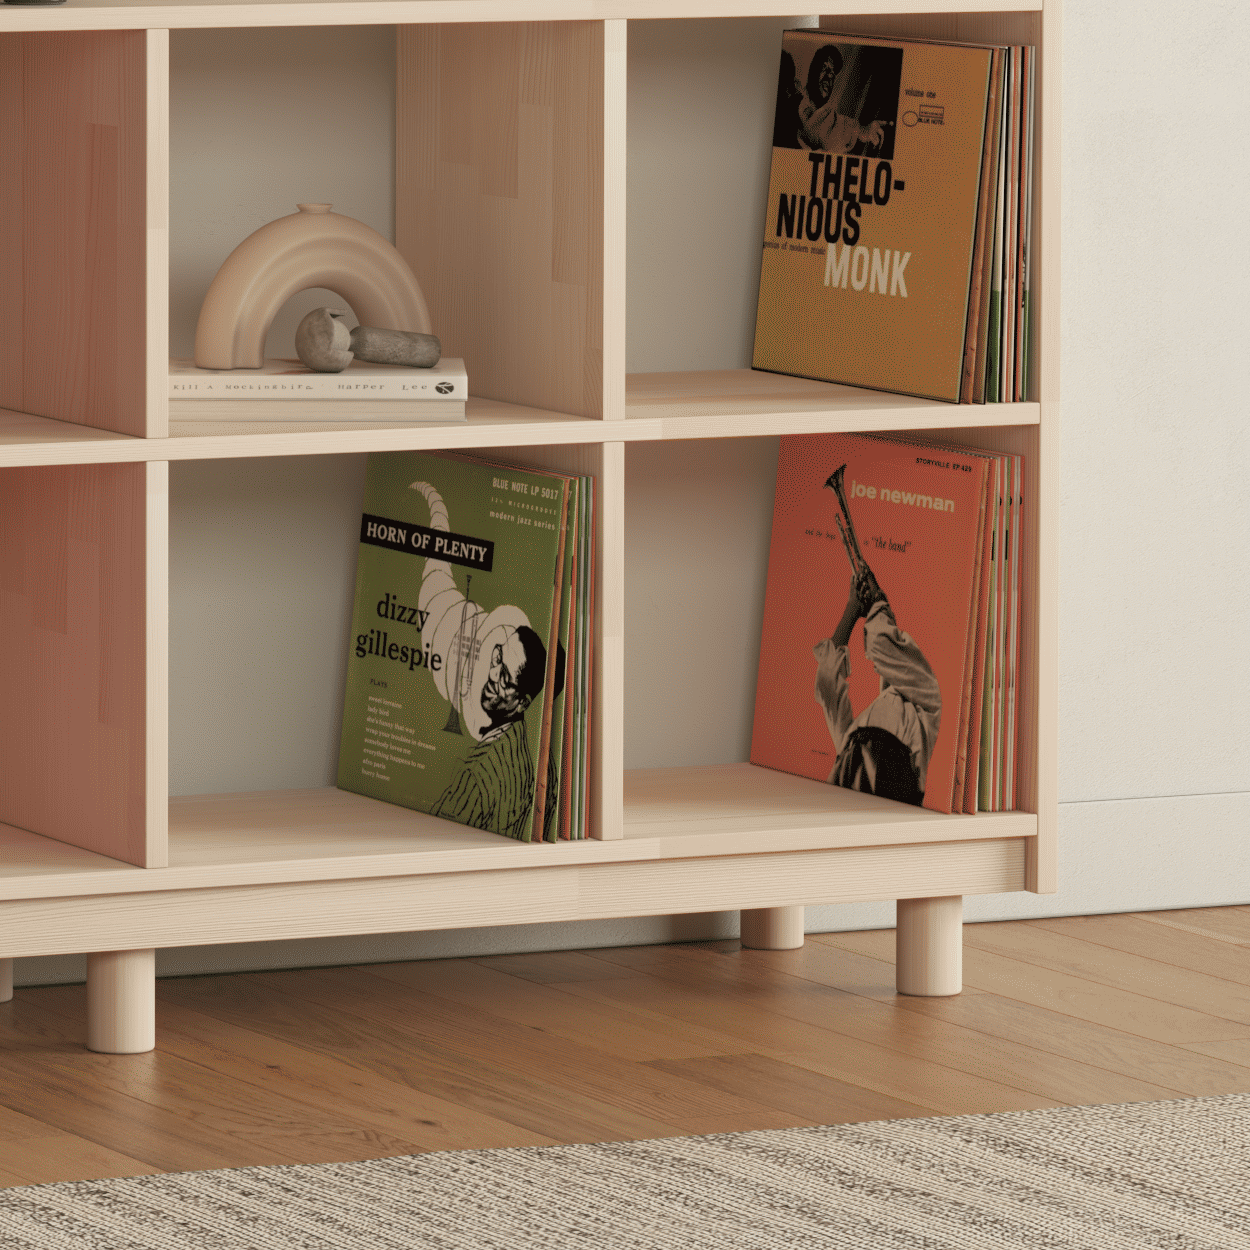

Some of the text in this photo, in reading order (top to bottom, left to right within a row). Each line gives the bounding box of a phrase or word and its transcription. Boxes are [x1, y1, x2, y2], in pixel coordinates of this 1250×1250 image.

[904, 87, 937, 99] volume one
[808, 152, 905, 206] THELO-
[776, 193, 862, 247] NIOUS
[824, 243, 912, 298] MONK
[402, 383, 429, 391] Lee
[915, 457, 950, 469] STORYVILLE
[492, 477, 509, 491] BLUE
[511, 481, 528, 495] NOTE
[530, 485, 540, 496] LP
[541, 487, 559, 500] 5017
[850, 480, 956, 513] joe newman
[489, 510, 556, 531] modern jazz series
[366, 521, 488, 563] HORN OF PLENTY
[376, 592, 430, 633] dizzy
[355, 629, 442, 671] gillespie
[369, 678, 388, 689] PLAYS
[367, 705, 378, 713] lady
